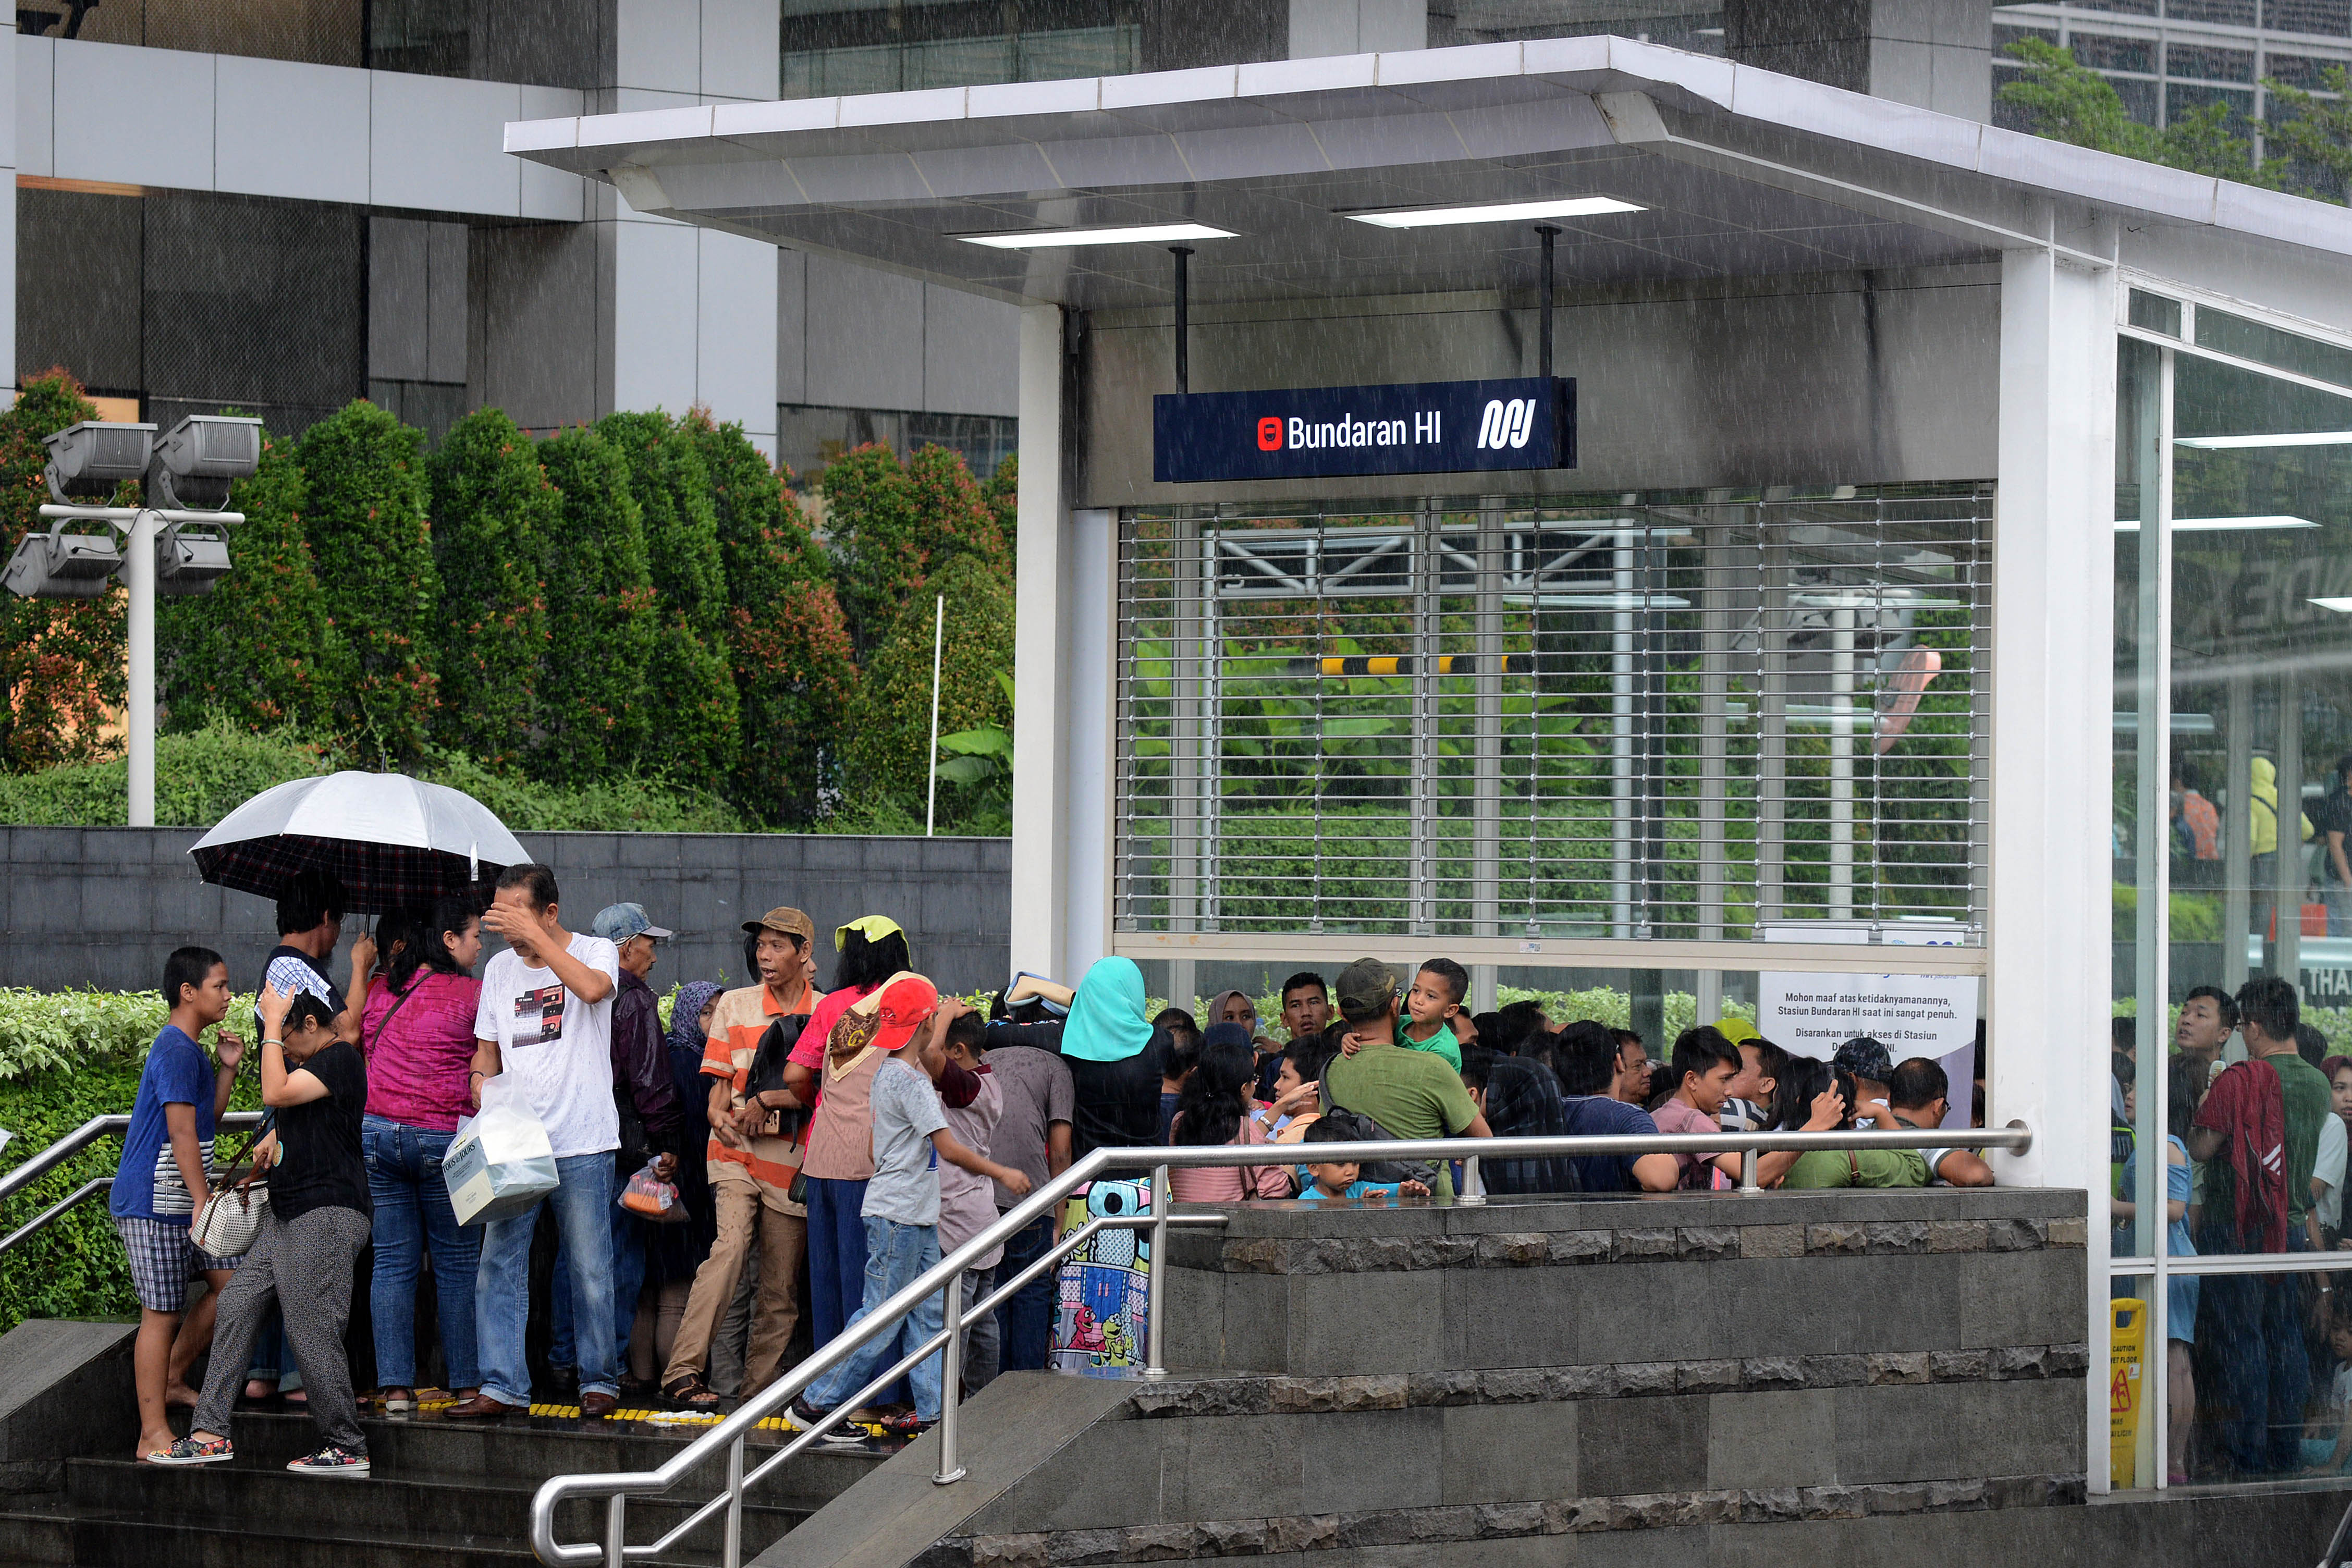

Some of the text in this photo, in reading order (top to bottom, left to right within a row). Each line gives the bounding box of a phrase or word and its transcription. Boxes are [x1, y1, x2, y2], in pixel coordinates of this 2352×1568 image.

[1289, 411, 1440, 449] Bundaran HI
[2308, 967, 2352, 995] THA
[1785, 993, 1951, 1007] Mohon maaf atas ketidaknyamanannya,
[1778, 1006, 1809, 1015] Stasiun
[1811, 1006, 1851, 1016] Bundaran
[1853, 1007, 1860, 1016] HI
[1883, 1008, 1894, 1017] ini
[1896, 1010, 1925, 1020] sangat
[1927, 1009, 1957, 1020] penuh.
[1796, 1027, 1937, 1040] Disarankan untuk akses di Stasiun
[1883, 1043, 1897, 1052] NI.
[443, 1157, 456, 1173] TOUS
[459, 1142, 475, 1162] JOURS
